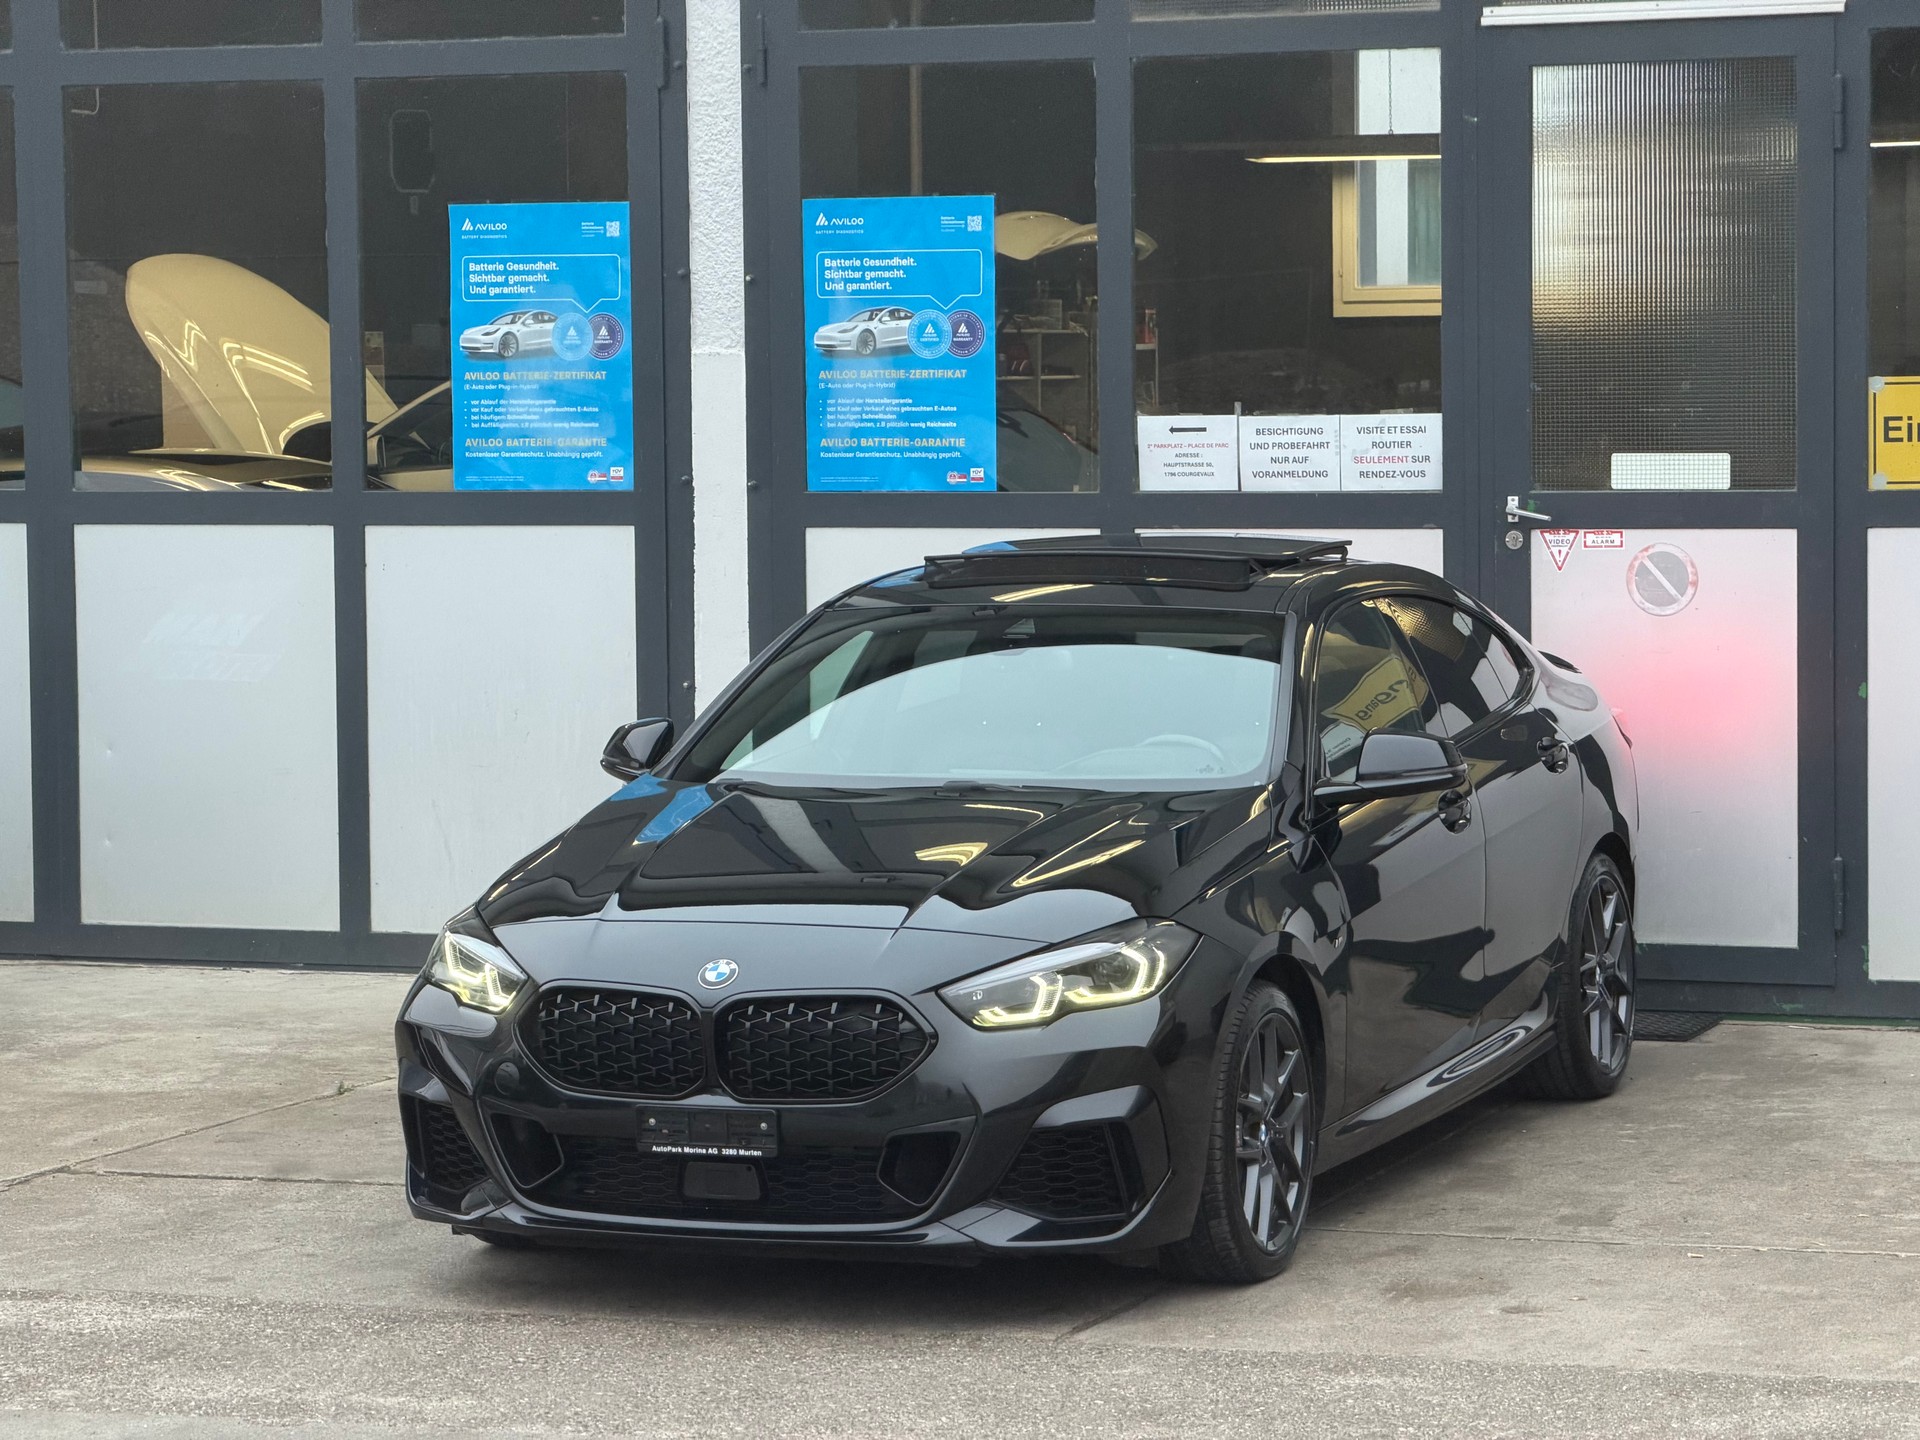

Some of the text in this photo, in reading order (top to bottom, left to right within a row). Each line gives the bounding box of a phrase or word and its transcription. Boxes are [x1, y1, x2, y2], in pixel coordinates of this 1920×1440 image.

[825, 257, 917, 267] Batterie Gesundheit.
[469, 262, 559, 271] Batterie Gesundheit.
[469, 273, 550, 284] Sichtbar gemacht.
[825, 269, 906, 280] Sichtbar gemacht.
[470, 285, 536, 296] Und garantiert.
[825, 281, 892, 292] Und garantiert.
[464, 371, 607, 380] AVILOO BATTERIE-ZERTIFIKAT
[819, 370, 967, 379] AVILOO BATTERIE-ZERTIFIKAT
[856, 382, 895, 390] Plug-in-Hybrid)
[1256, 428, 1324, 436] BESICHTIGUNG
[1387, 426, 1397, 434] ET
[1400, 426, 1426, 434] ESSAI
[465, 438, 607, 447] AVILOO BATTERIE-GARANTIE
[820, 438, 965, 447] AVILOO BATTERIE-GARANTIE
[1250, 442, 1330, 450] UND PROBEFAHRT
[1372, 441, 1412, 449] ROUTIER
[546, 451, 580, 459] Unabhängig
[581, 451, 603, 459] geprüft.
[939, 451, 962, 459] geprüft.
[1292, 456, 1309, 464] AUF
[1354, 456, 1409, 464] SEULEMENT
[1252, 470, 1328, 478] VORANMELDUNG
[1359, 470, 1426, 479] RENDEZ-VOUS
[652, 1145, 682, 1153] AutoPark
